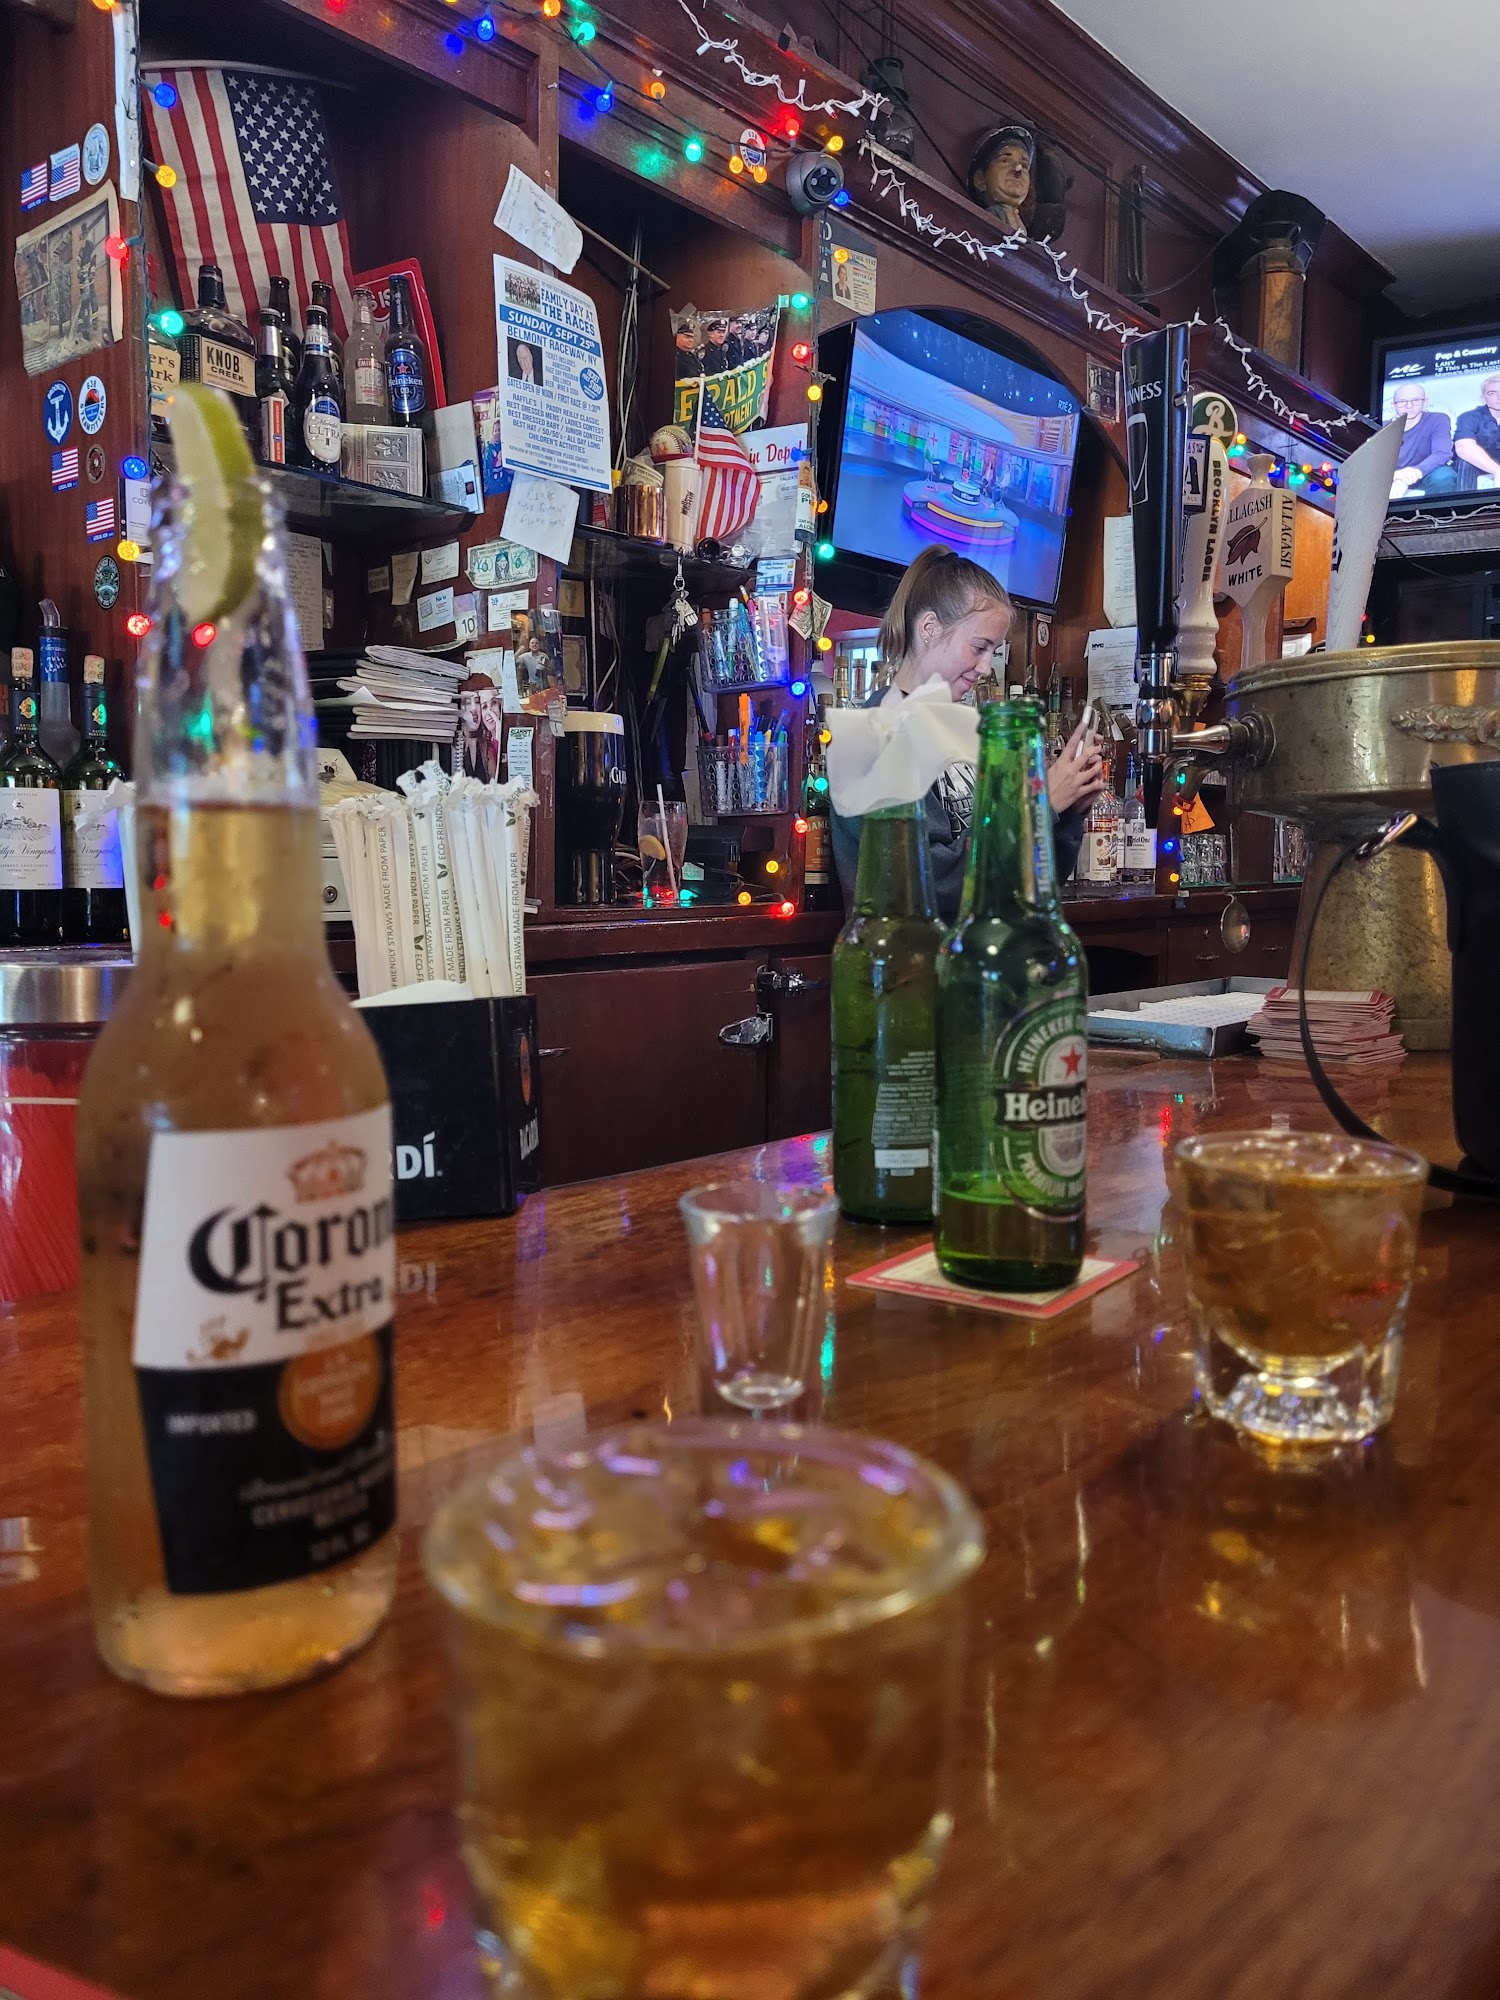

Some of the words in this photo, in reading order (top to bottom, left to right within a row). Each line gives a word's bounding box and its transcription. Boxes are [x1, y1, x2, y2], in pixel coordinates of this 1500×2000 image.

[541, 288, 569, 312] FAMILY
[570, 300, 584, 317] DAY
[586, 310, 594, 323] AT
[508, 311, 554, 337] SUNDAY,
[555, 327, 579, 346] SEPT
[542, 303, 563, 322] THE
[566, 312, 596, 337] RACES
[207, 346, 240, 374] KNOB
[508, 326, 548, 348] BELMONT
[550, 340, 587, 363] RACEWAY,
[588, 356, 598, 367] NY
[1435, 352, 1453, 361] Pop
[1454, 350, 1461, 358] &
[1462, 346, 1498, 357] Country
[211, 366, 245, 383] CREEK
[1435, 360, 1456, 368] LANY
[507, 378, 523, 389] GATES
[523, 382, 535, 392] OPEN
[542, 387, 554, 399] NOON
[558, 394, 570, 406] FIRST
[570, 397, 582, 409] RACE
[507, 400, 521, 412] BEST
[522, 404, 545, 418] DRESSED
[545, 410, 560, 422] MENS
[565, 417, 582, 429] LADIES
[583, 423, 604, 435] CONTEST
[508, 409, 521, 420] BEST
[523, 413, 545, 427] DRESSED
[546, 420, 560, 431] BABY
[565, 426, 582, 437] JUNIOR
[583, 431, 604, 443] CONTEST
[546, 404, 562, 417] PADDY
[563, 408, 579, 420] REILLY
[580, 413, 600, 426] CLASSIC
[308, 426, 341, 440] ULTRA
[513, 419, 527, 430] BEST
[527, 423, 537, 433] HAT
[567, 434, 577, 443] ALL
[577, 437, 587, 447] DAY
[588, 440, 601, 450] LONG
[529, 432, 558, 447] CHILDREN'S
[559, 441, 586, 454] ACTIVITIES
[1209, 460, 1221, 535] BROOKLYN
[1281, 494, 1294, 570] ALLAGASH
[1202, 539, 1216, 583] LAGER
[1228, 565, 1264, 588] WHITE
[462, 618, 476, 634] 10
[378, 827, 387, 853] PAPER
[380, 856, 389, 882] FROM
[421, 845, 429, 872] PAPER
[510, 852, 518, 878] PAPER
[383, 883, 392, 910] MADE
[410, 872, 418, 897] FROM
[422, 874, 431, 900] FROM
[511, 880, 520, 906] FROM
[385, 911, 395, 946] STRAWS
[425, 902, 433, 928] MADE
[512, 908, 521, 934] MADE
[446, 946, 454, 971] MADE
[514, 936, 523, 970] STRAWS
[391, 1131, 437, 1180] DÍ
[187, 1198, 396, 1302] Coron
[276, 1279, 385, 1333] Extra
